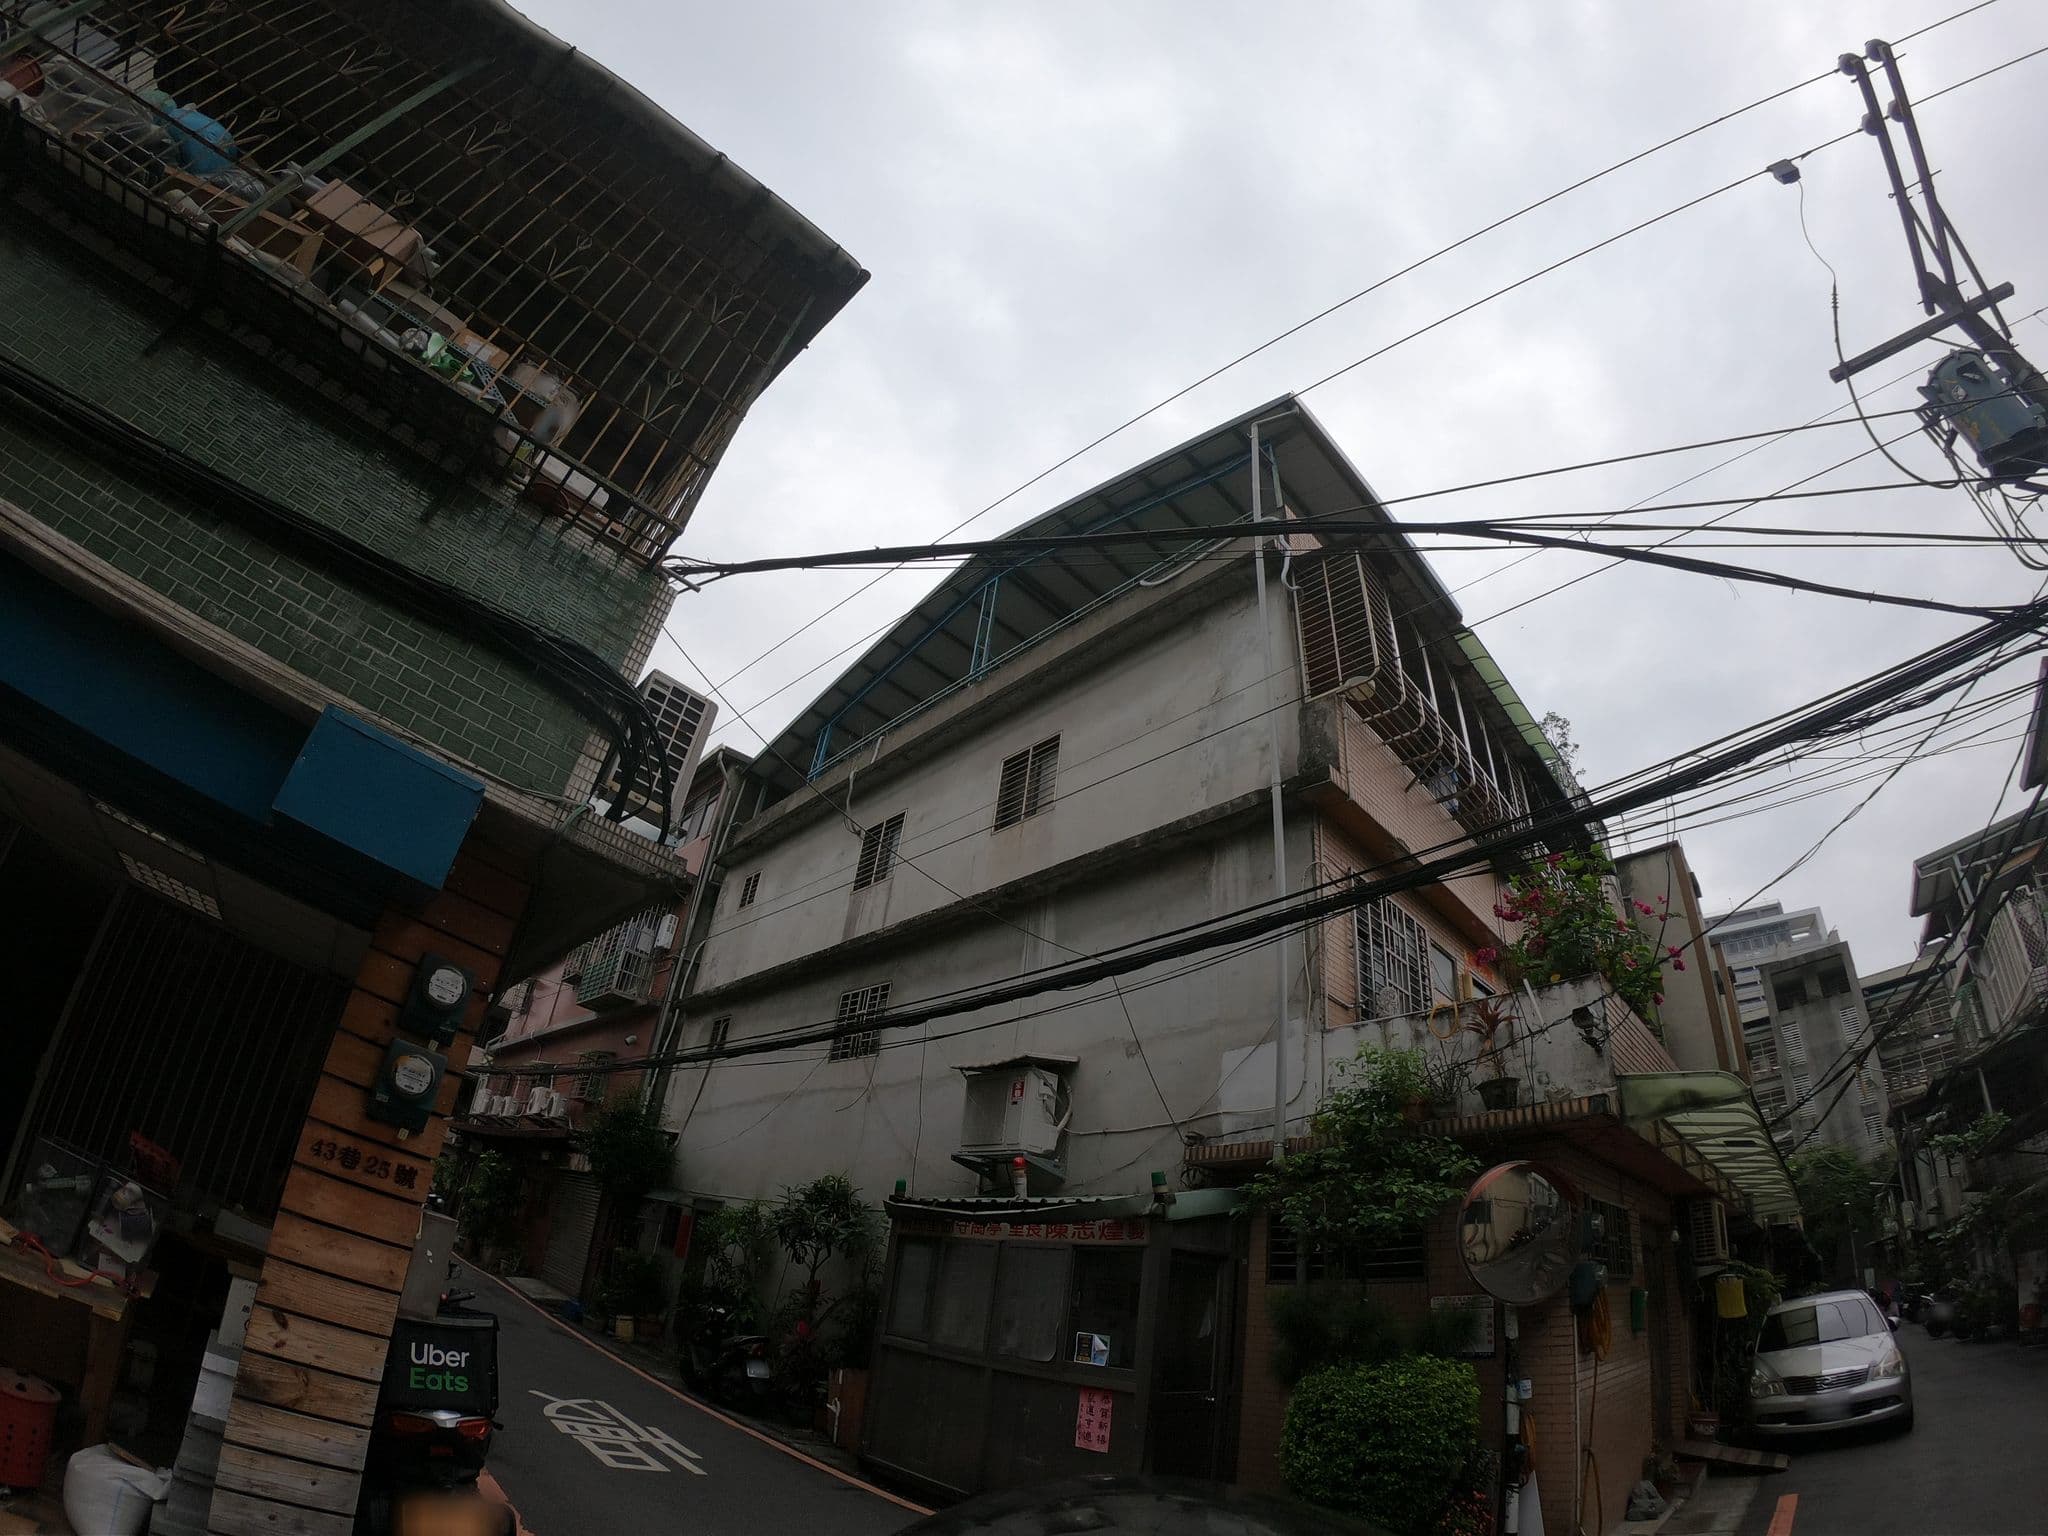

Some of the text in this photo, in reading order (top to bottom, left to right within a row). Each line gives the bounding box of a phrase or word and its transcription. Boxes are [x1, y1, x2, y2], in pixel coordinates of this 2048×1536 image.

[311, 1139, 418, 1189] 43巷25號
[410, 1342, 470, 1368] Uber
[409, 1367, 469, 1392] Eats
[527, 1390, 708, 1476] 慢
